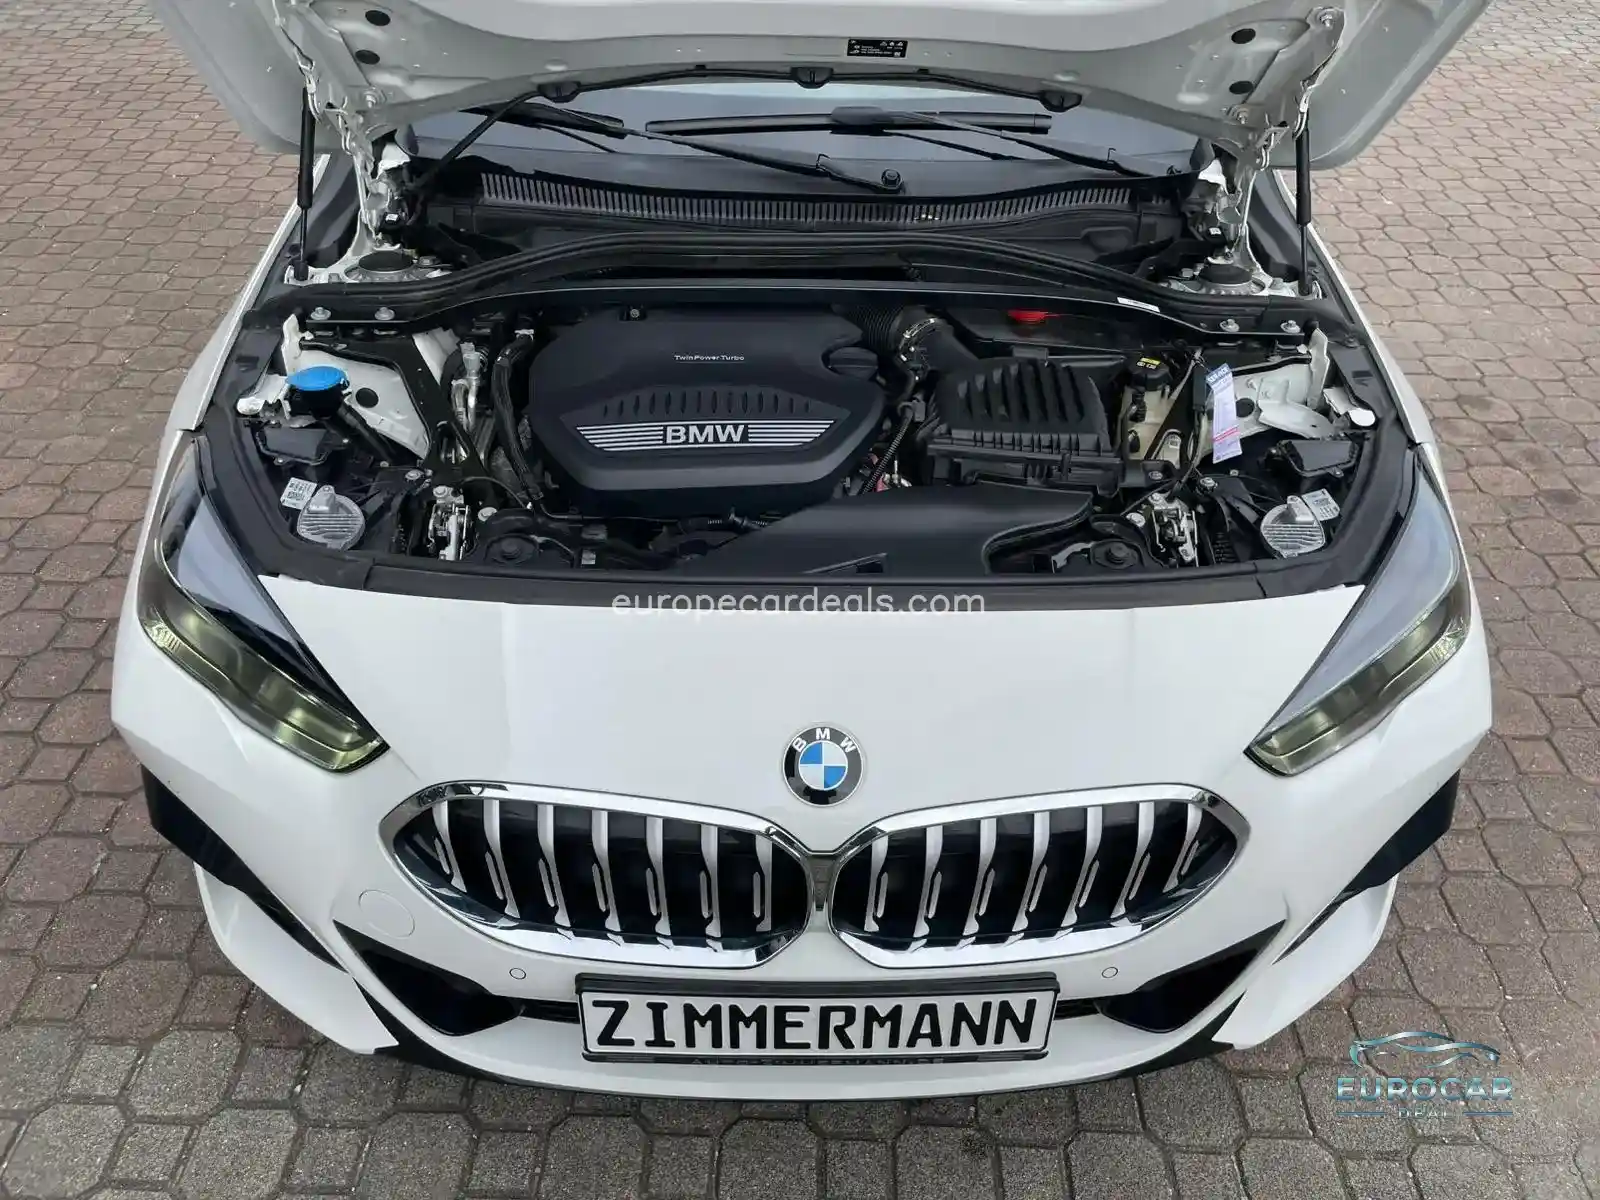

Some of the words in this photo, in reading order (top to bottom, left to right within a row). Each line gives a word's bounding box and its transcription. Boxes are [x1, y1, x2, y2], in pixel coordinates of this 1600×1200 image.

[665, 424, 745, 443] BMW
[792, 727, 857, 753] BMW
[592, 998, 1038, 1050] ZIMMERMANN
